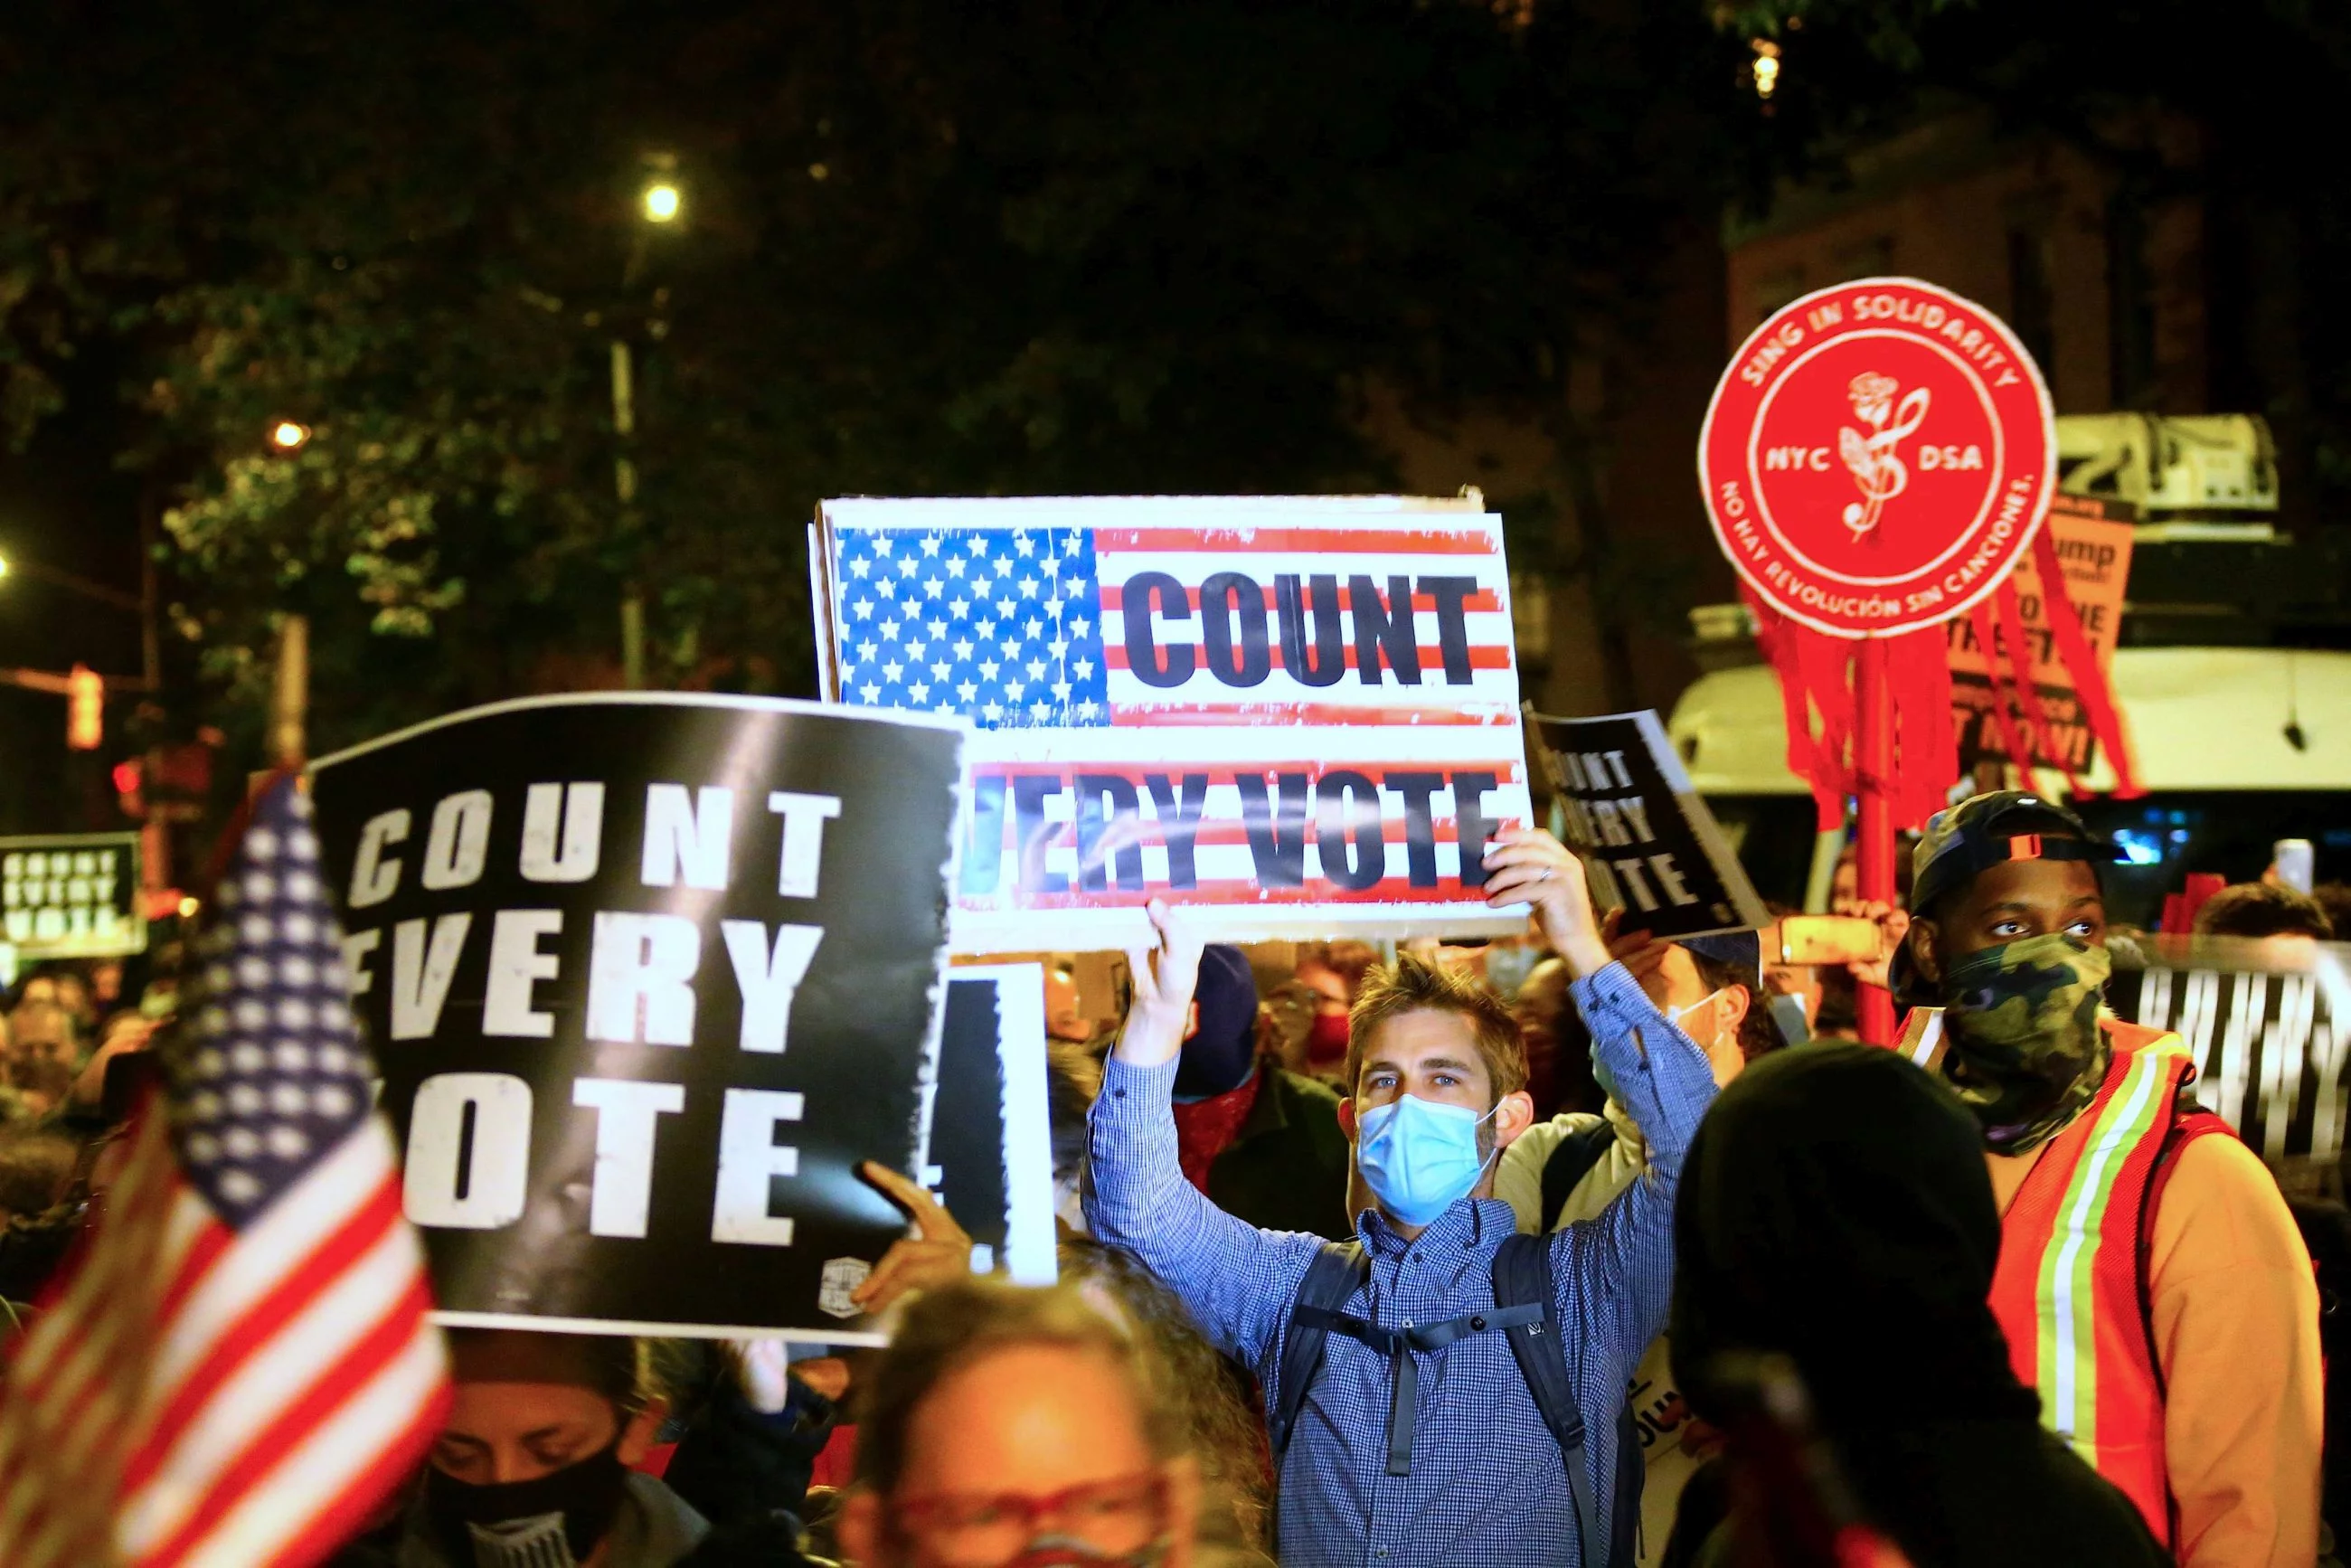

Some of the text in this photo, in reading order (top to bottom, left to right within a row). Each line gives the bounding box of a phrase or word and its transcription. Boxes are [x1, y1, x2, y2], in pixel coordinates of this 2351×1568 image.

[1741, 294, 2021, 389] SING IN SOLIDARITY
[1764, 444, 1984, 472] NYC DSA
[1720, 480, 1746, 516] NO
[1733, 519, 1770, 563] HAY
[1764, 559, 1902, 619] REVOLUCIÓN
[1907, 588, 1944, 613] SIN
[1121, 571, 1479, 688] COUNT
[347, 781, 842, 909] COUNT
[959, 770, 1499, 894] VERY VOTE
[373, 1072, 806, 1246] OTE
